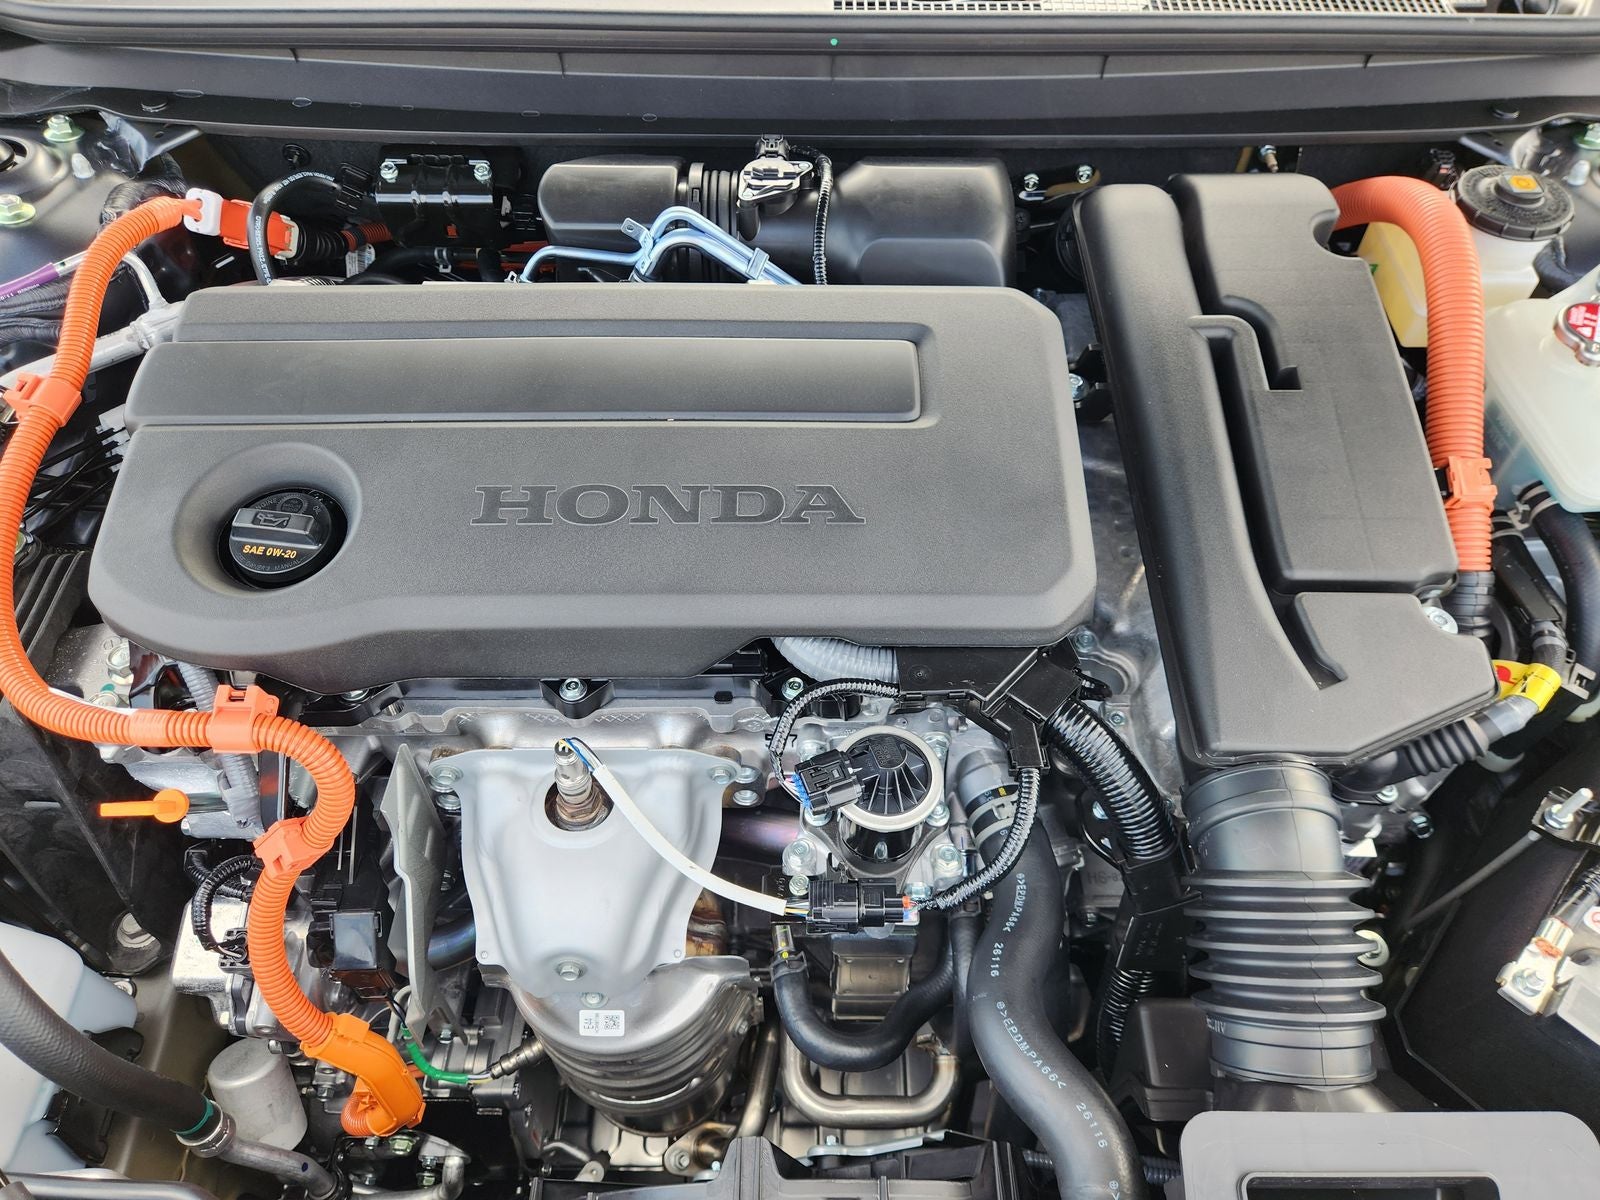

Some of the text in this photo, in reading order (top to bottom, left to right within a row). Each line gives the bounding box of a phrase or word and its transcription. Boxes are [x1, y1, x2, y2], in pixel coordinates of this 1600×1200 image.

[469, 483, 867, 526] HONDA
[242, 544, 297, 559] SAE 0W-20
[990, 942, 1004, 977] 26116
[1075, 1101, 1108, 1149] 26116
